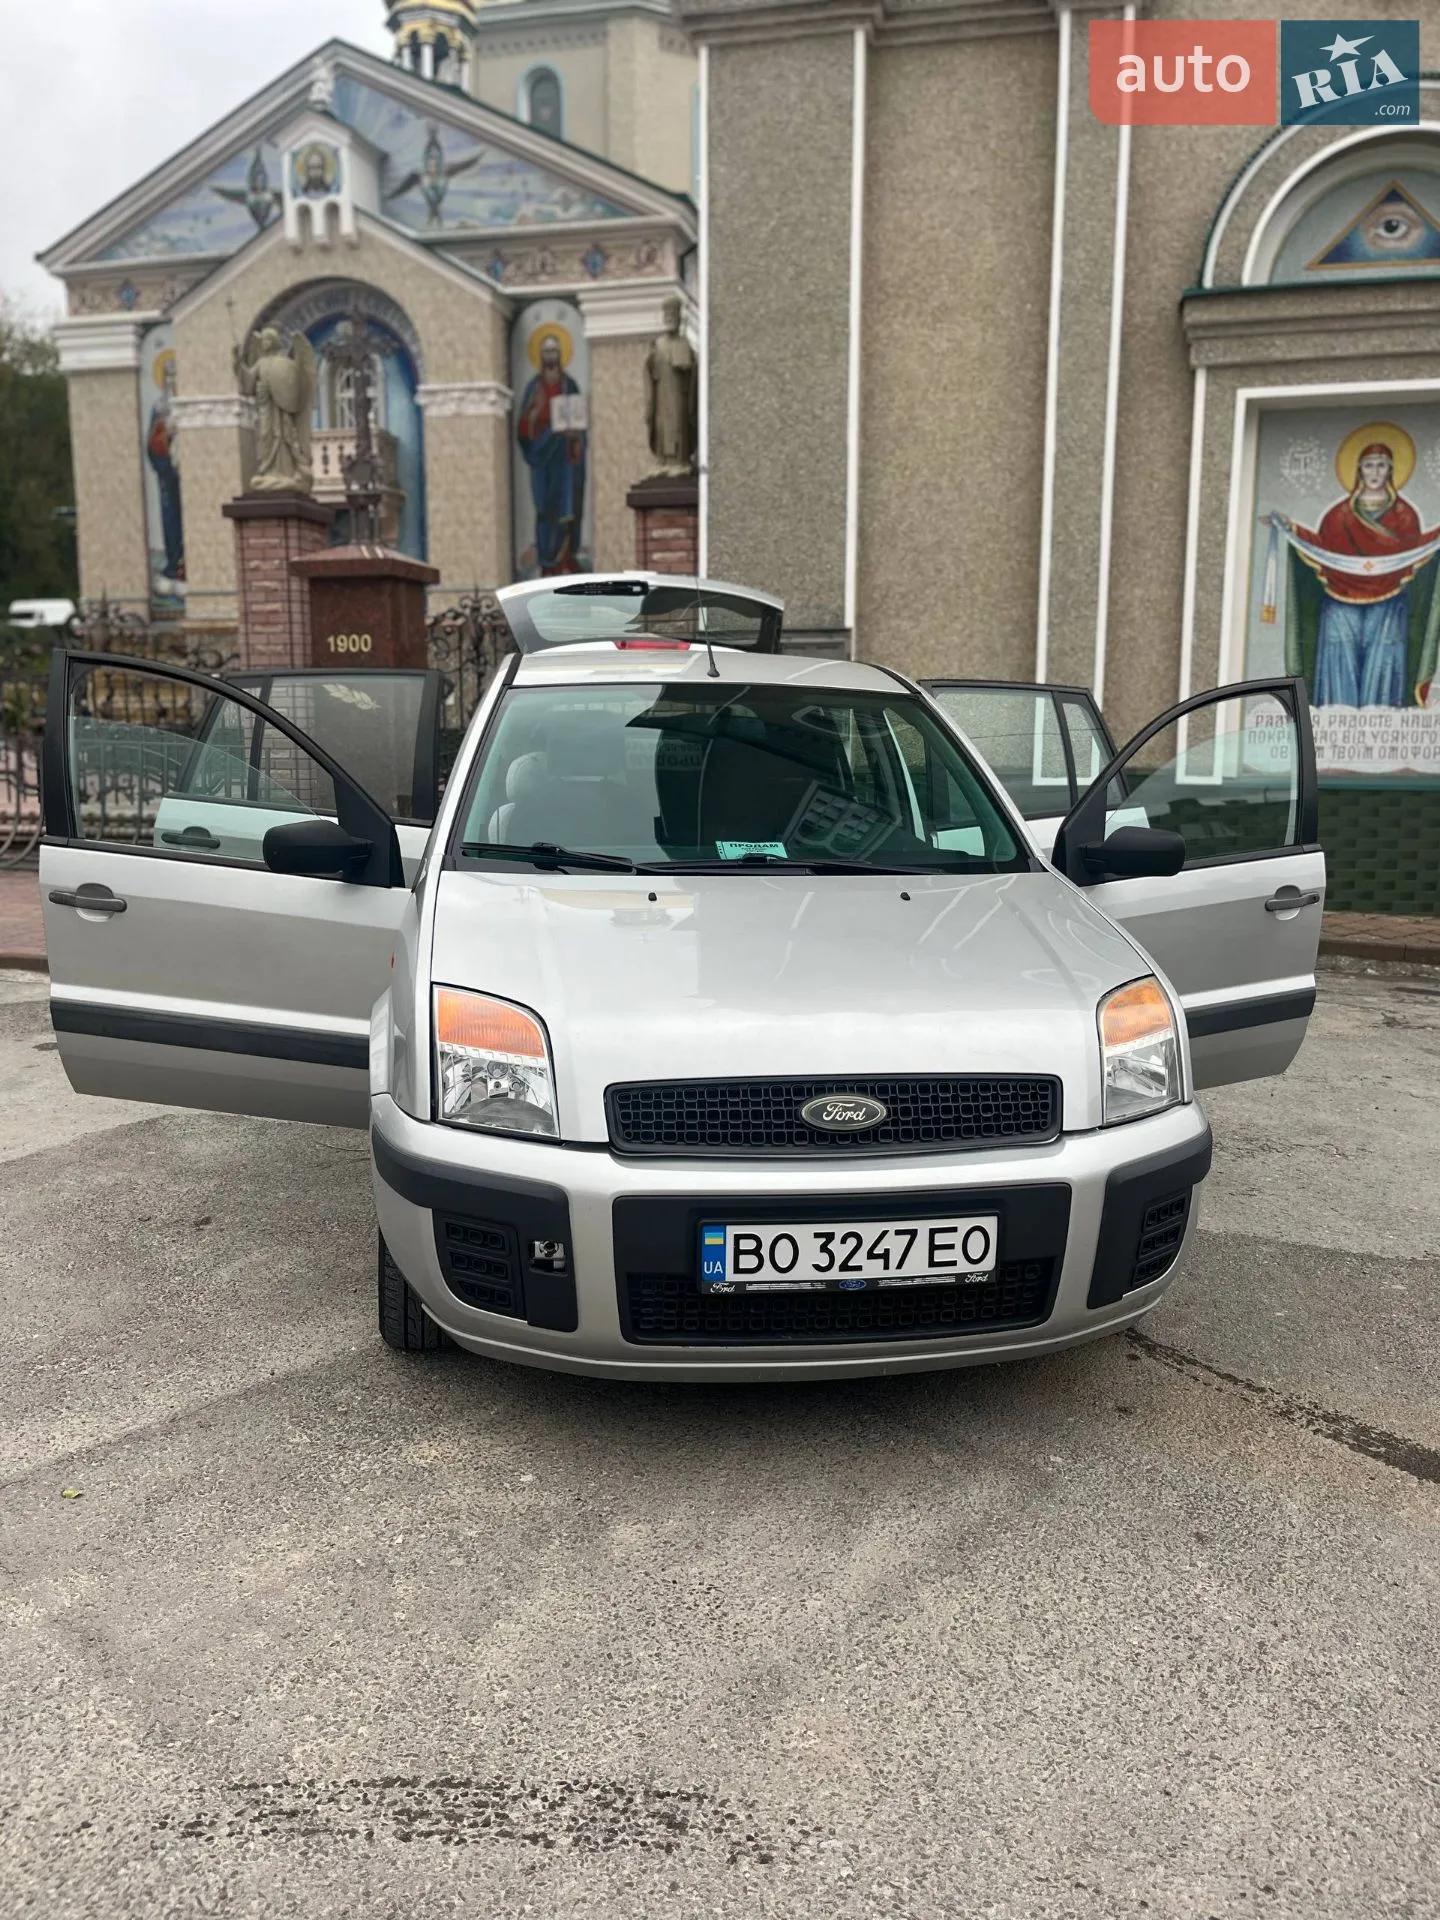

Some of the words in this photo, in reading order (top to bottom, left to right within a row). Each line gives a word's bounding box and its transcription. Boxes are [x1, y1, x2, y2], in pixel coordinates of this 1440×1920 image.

[327, 634, 372, 653] 1900
[822, 1102, 866, 1121] Ford
[733, 1232, 800, 1275] BO
[812, 1228, 919, 1273] 3247
[927, 1224, 991, 1268] EO
[704, 1261, 724, 1275] UA
[964, 1272, 990, 1284] Ford
